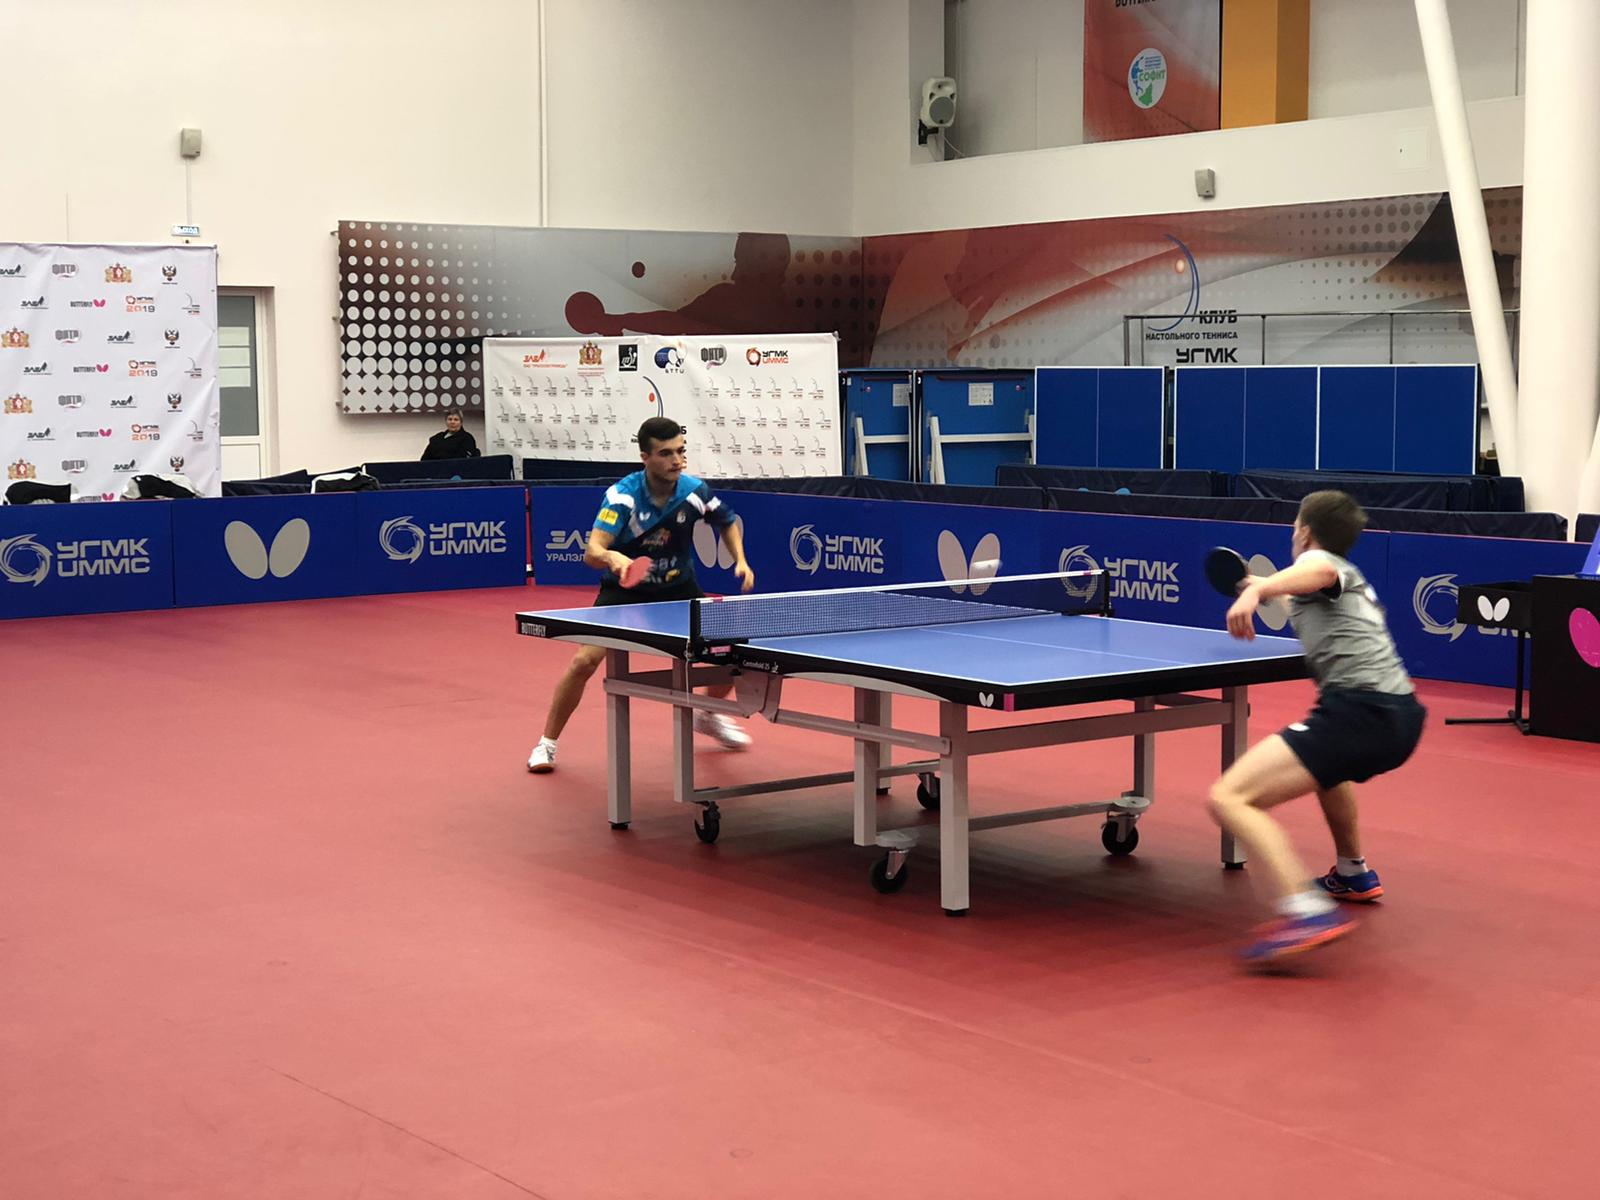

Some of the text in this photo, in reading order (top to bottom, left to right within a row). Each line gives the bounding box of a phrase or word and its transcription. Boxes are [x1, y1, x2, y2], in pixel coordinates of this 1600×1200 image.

[126, 305, 155, 313] 2019
[1199, 310, 1238, 324] КЛУБ
[1145, 331, 1239, 341] НАСТОЛЬНОГО ТЕННИСА
[762, 350, 789, 358] УГМК
[1176, 348, 1239, 363] УГМК
[131, 433, 161, 441] 2019
[429, 521, 506, 539] УГМК
[57, 538, 149, 559] УГМК
[430, 537, 507, 556] UMMC
[825, 535, 884, 556] УГМК
[58, 557, 151, 577] UMMC
[825, 554, 884, 574] UMMC
[1104, 557, 1180, 583] УГМК
